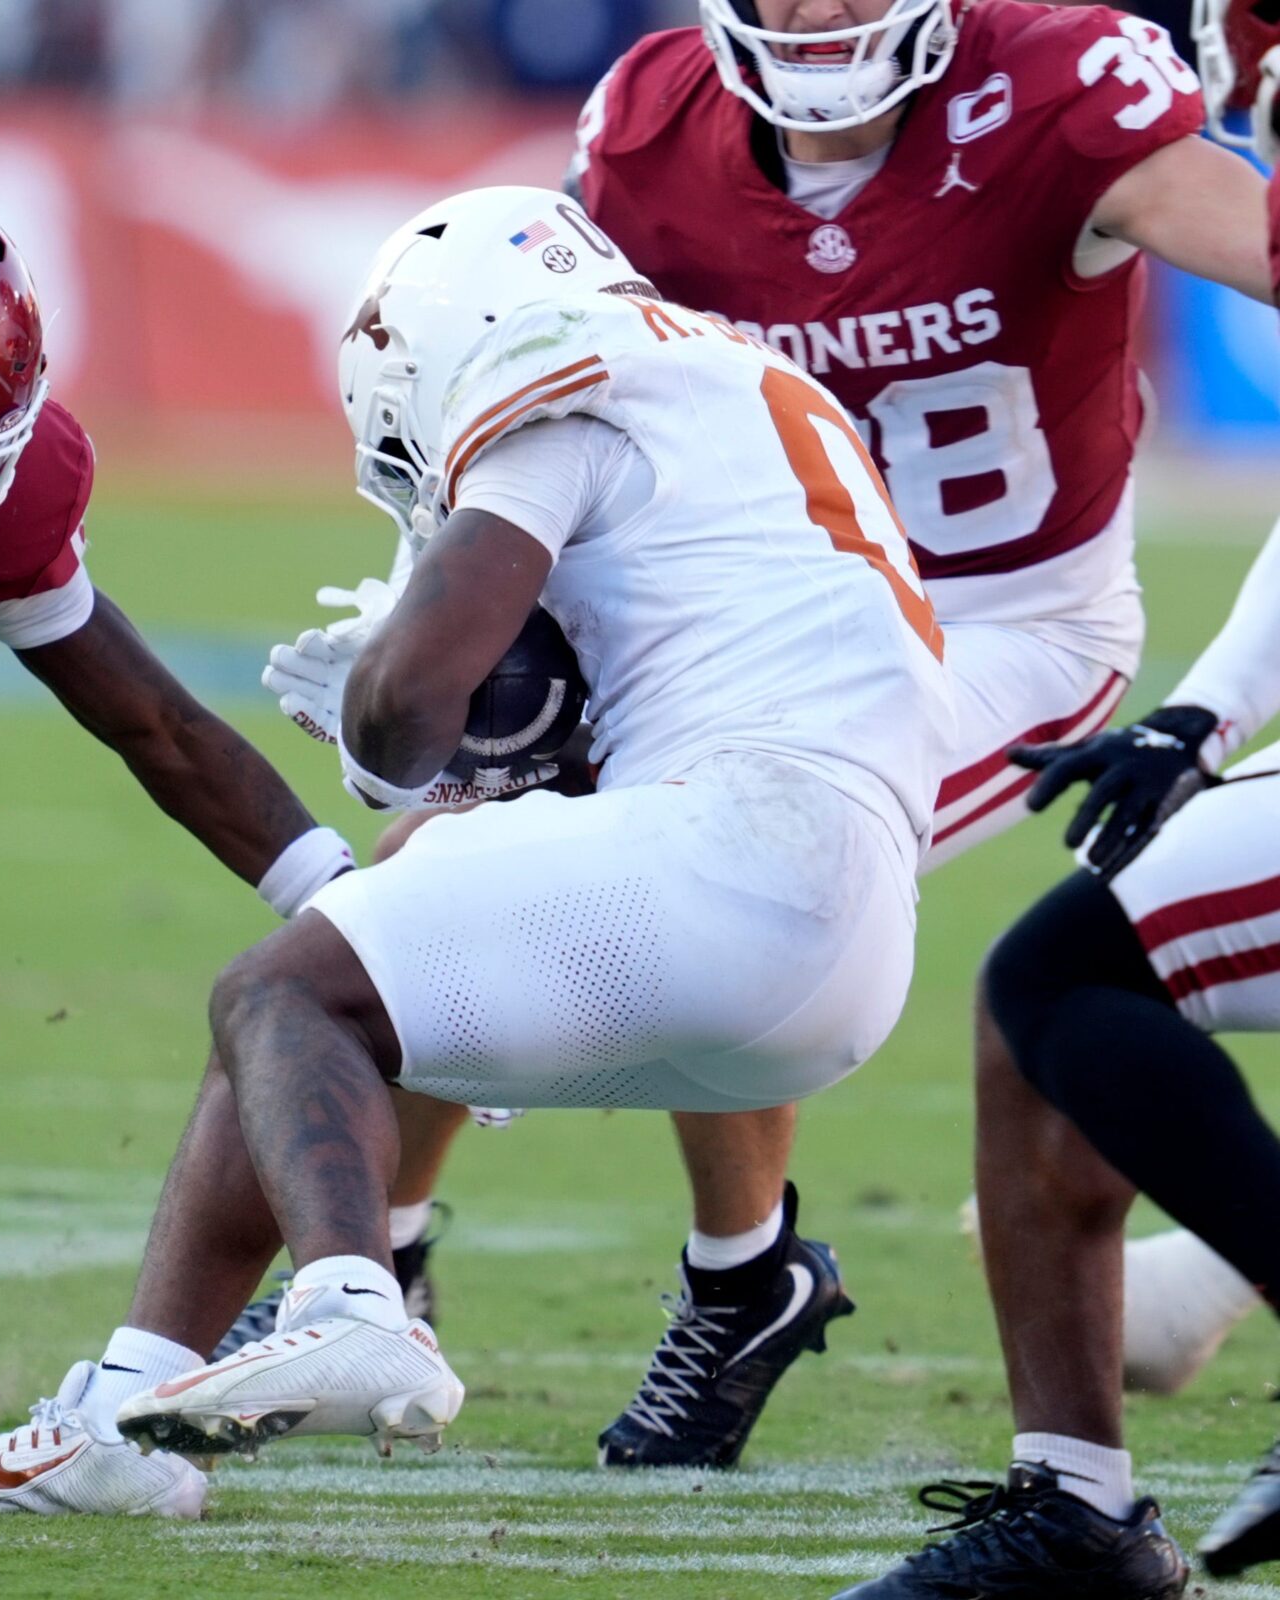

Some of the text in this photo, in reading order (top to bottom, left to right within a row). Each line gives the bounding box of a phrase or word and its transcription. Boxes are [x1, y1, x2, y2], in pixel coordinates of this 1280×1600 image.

[1076, 15, 1202, 130] 38
[542, 244, 577, 273] SEC
[556, 203, 615, 259] 0
[704, 287, 1002, 375] ONERS
[846, 360, 1058, 556] 8
[759, 364, 946, 665] 0
